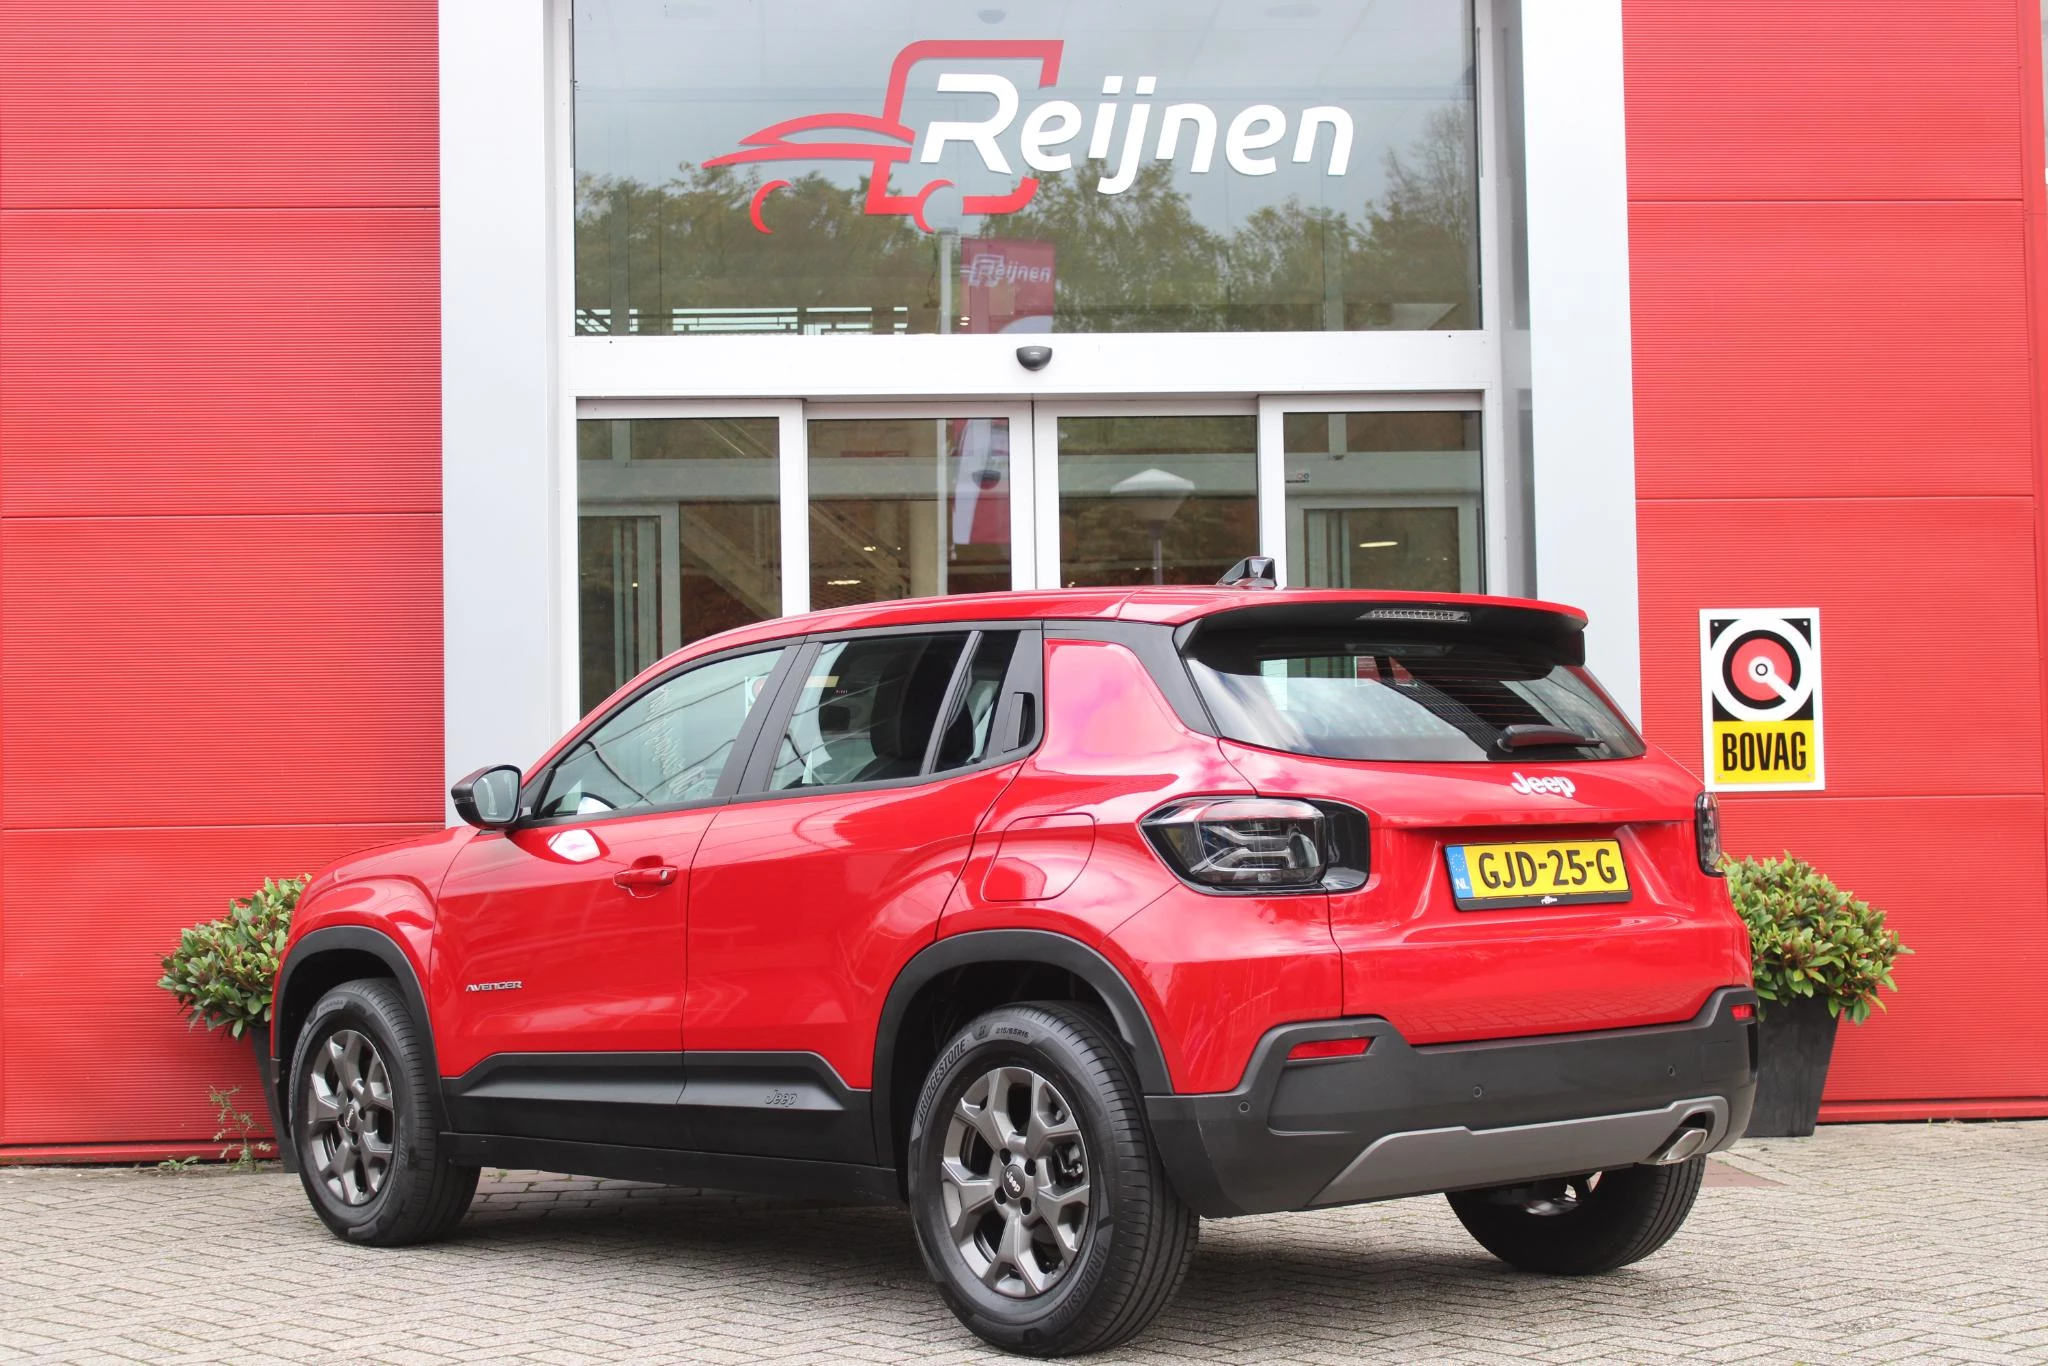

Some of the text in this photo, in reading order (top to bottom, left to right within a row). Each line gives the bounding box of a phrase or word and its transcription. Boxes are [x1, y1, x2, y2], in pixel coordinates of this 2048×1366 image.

[919, 73, 1354, 195] Reijnen
[1722, 731, 1806, 771] BOVAG
[1511, 771, 1576, 798] Jeep
[1478, 848, 1617, 889] GJD-25-G
[1455, 877, 1469, 890] NL
[465, 980, 523, 992] AVENGER
[764, 1089, 798, 1108] Jeep
